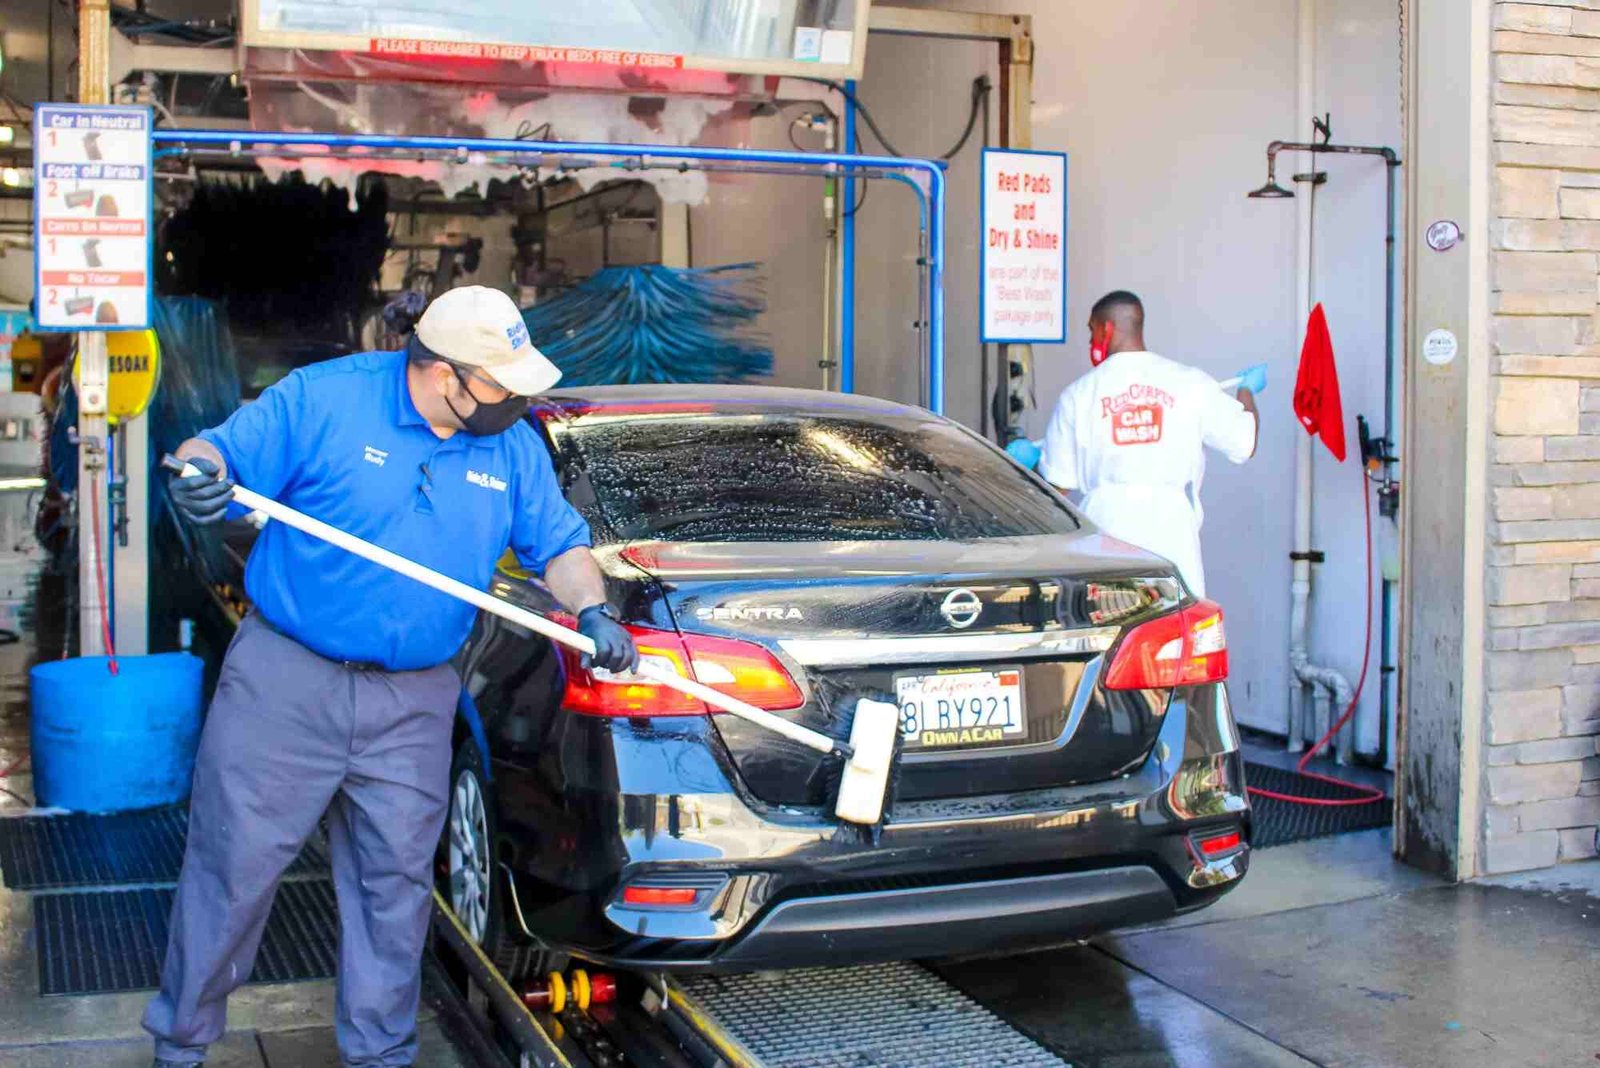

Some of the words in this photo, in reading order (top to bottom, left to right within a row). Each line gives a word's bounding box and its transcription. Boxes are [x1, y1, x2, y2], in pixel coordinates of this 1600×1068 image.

[376, 39, 418, 54] PLEASE
[420, 41, 481, 57] REMEMBER
[484, 44, 499, 58] TO
[501, 45, 527, 60] KEEP
[530, 47, 565, 62] TRUCK
[567, 49, 594, 63] BEDS
[596, 51, 621, 65] FREE
[623, 53, 637, 66] OF
[639, 54, 675, 68] DEBRIS
[52, 114, 74, 127] Car
[91, 115, 141, 128] Neutral
[48, 130, 57, 147] 1
[47, 164, 77, 178] Foot
[81, 165, 101, 178] off
[103, 165, 140, 179] Brake
[47, 181, 58, 198] 2
[998, 172, 1020, 192] Red
[1024, 173, 1051, 194] Pads
[1014, 202, 1036, 221] and
[48, 238, 57, 256] 1
[989, 228, 1009, 250] Dry
[1013, 229, 1022, 248] &
[1026, 229, 1059, 250] Shine
[48, 289, 58, 305] 2
[109, 355, 149, 373] ESOAK
[1120, 410, 1153, 426] CAR
[1115, 425, 1160, 442] WASH
[695, 607, 804, 621] SENTRA
